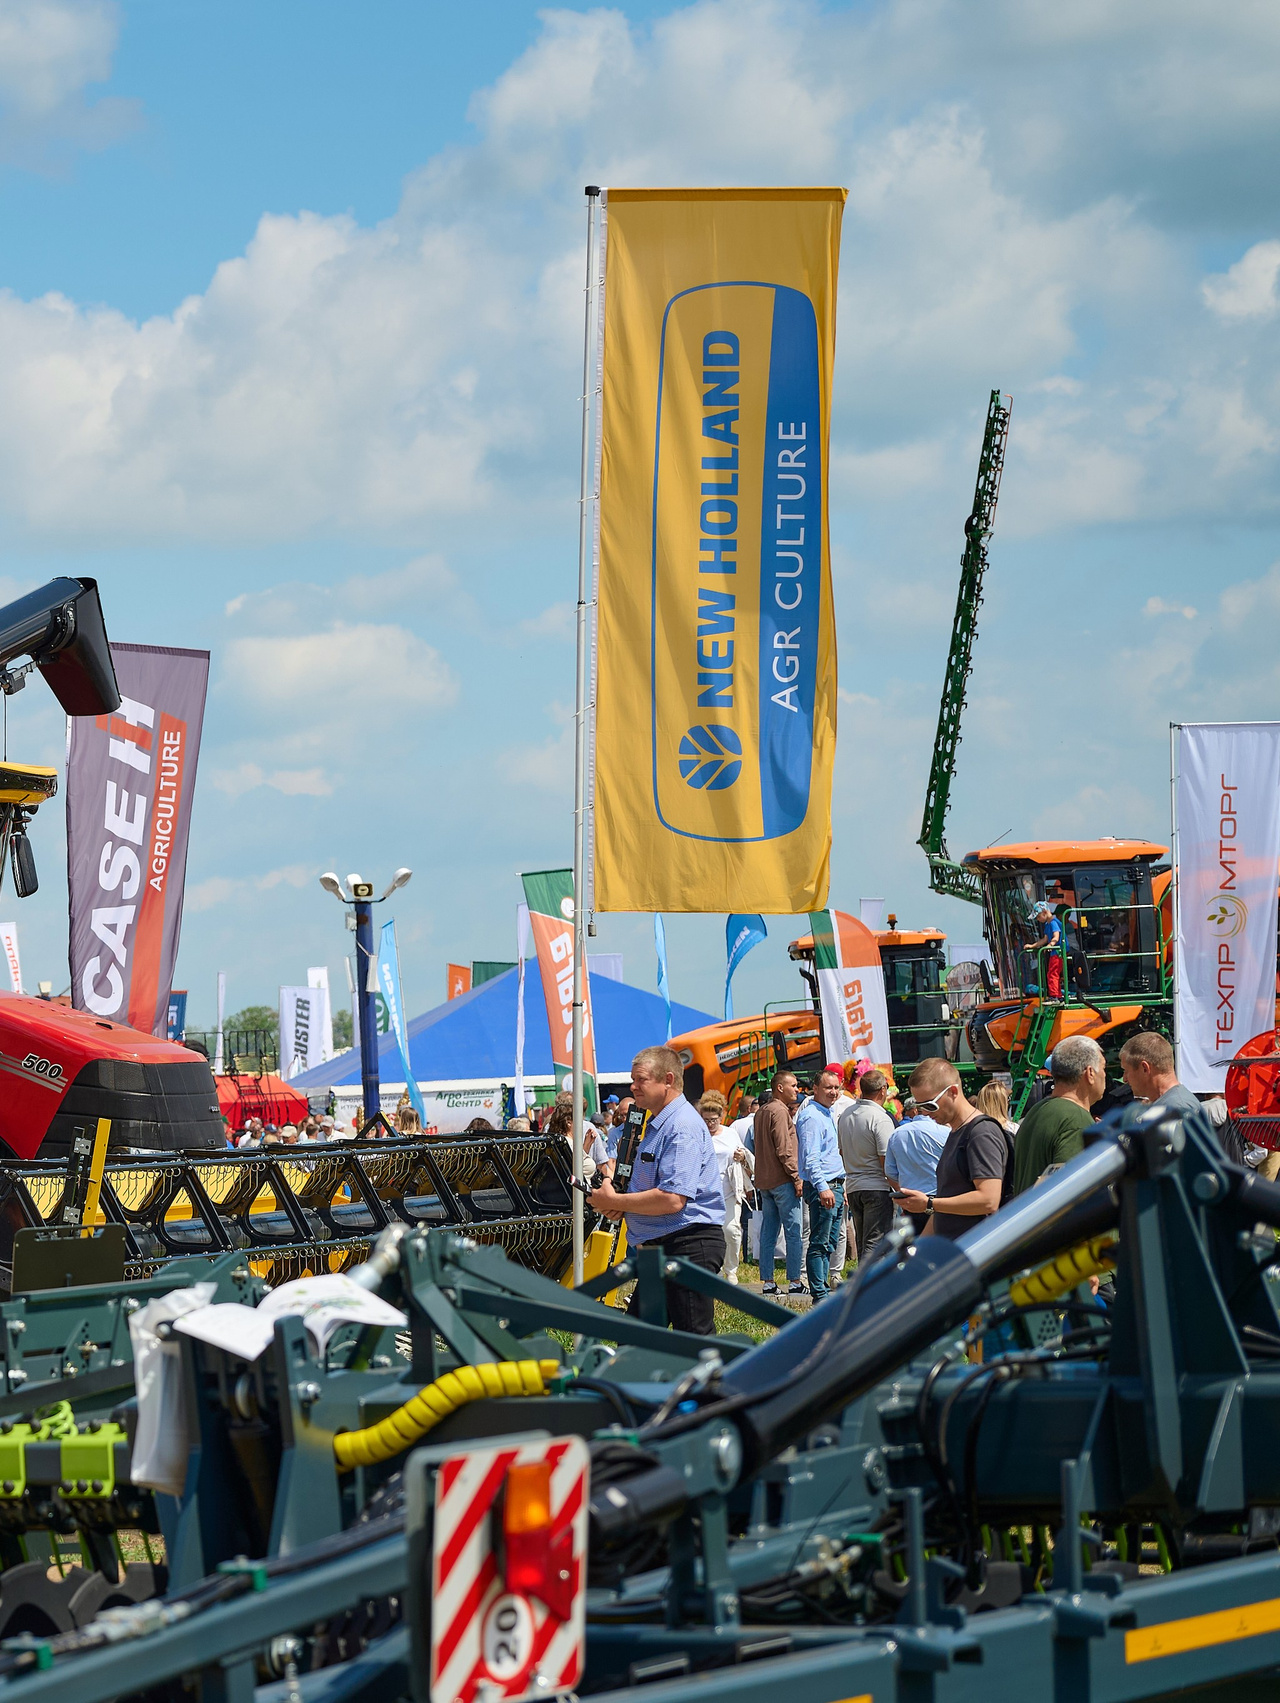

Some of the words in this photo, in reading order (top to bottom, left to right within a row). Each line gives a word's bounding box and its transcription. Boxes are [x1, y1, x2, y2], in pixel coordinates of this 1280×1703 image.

[697, 330, 740, 579] HOLLAND
[771, 420, 807, 713] AGRCULTURE
[696, 587, 736, 709] NEW
[150, 730, 181, 893] AGRICULTURE
[83, 780, 148, 1017] CASE
[21, 1052, 64, 1079] 500
[436, 1091, 462, 1102] Агро
[447, 1099, 482, 1108] Центр
[494, 1607, 518, 1666] 20
